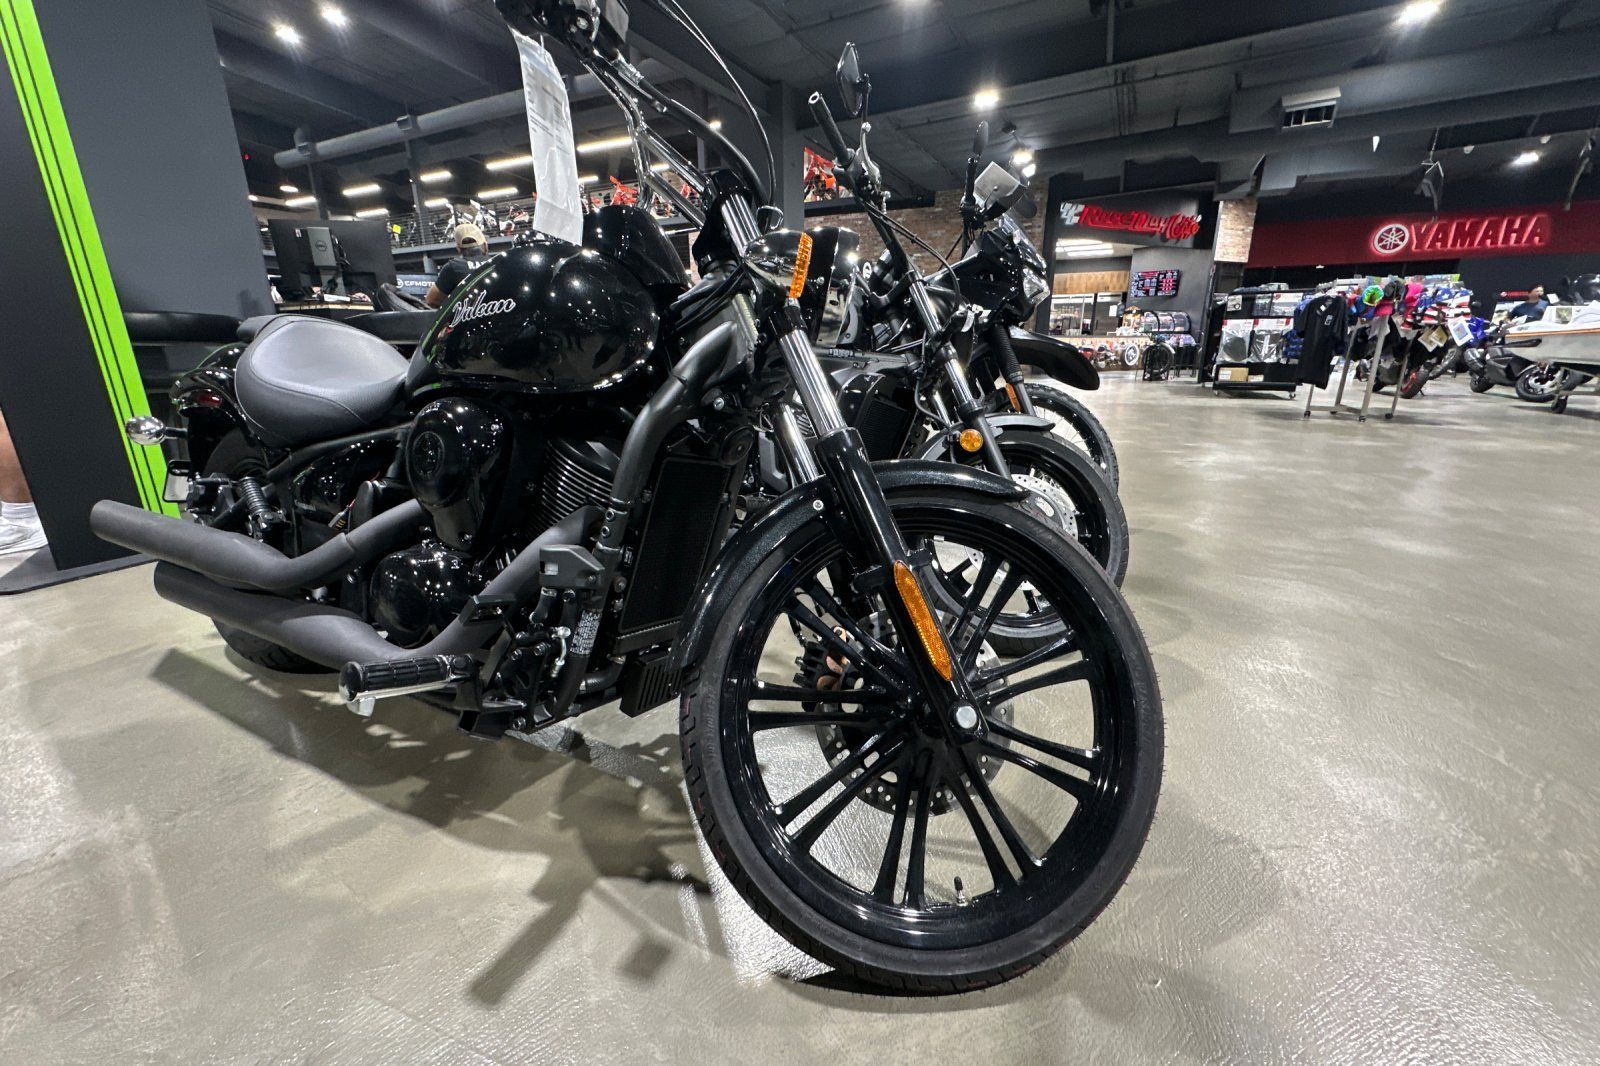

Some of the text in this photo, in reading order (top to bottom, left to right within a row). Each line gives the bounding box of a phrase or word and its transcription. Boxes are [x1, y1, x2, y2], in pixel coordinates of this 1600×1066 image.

[1079, 204, 1129, 229] Race
[1411, 214, 1547, 251] YAMAHA
[449, 290, 516, 327] Vulcan
